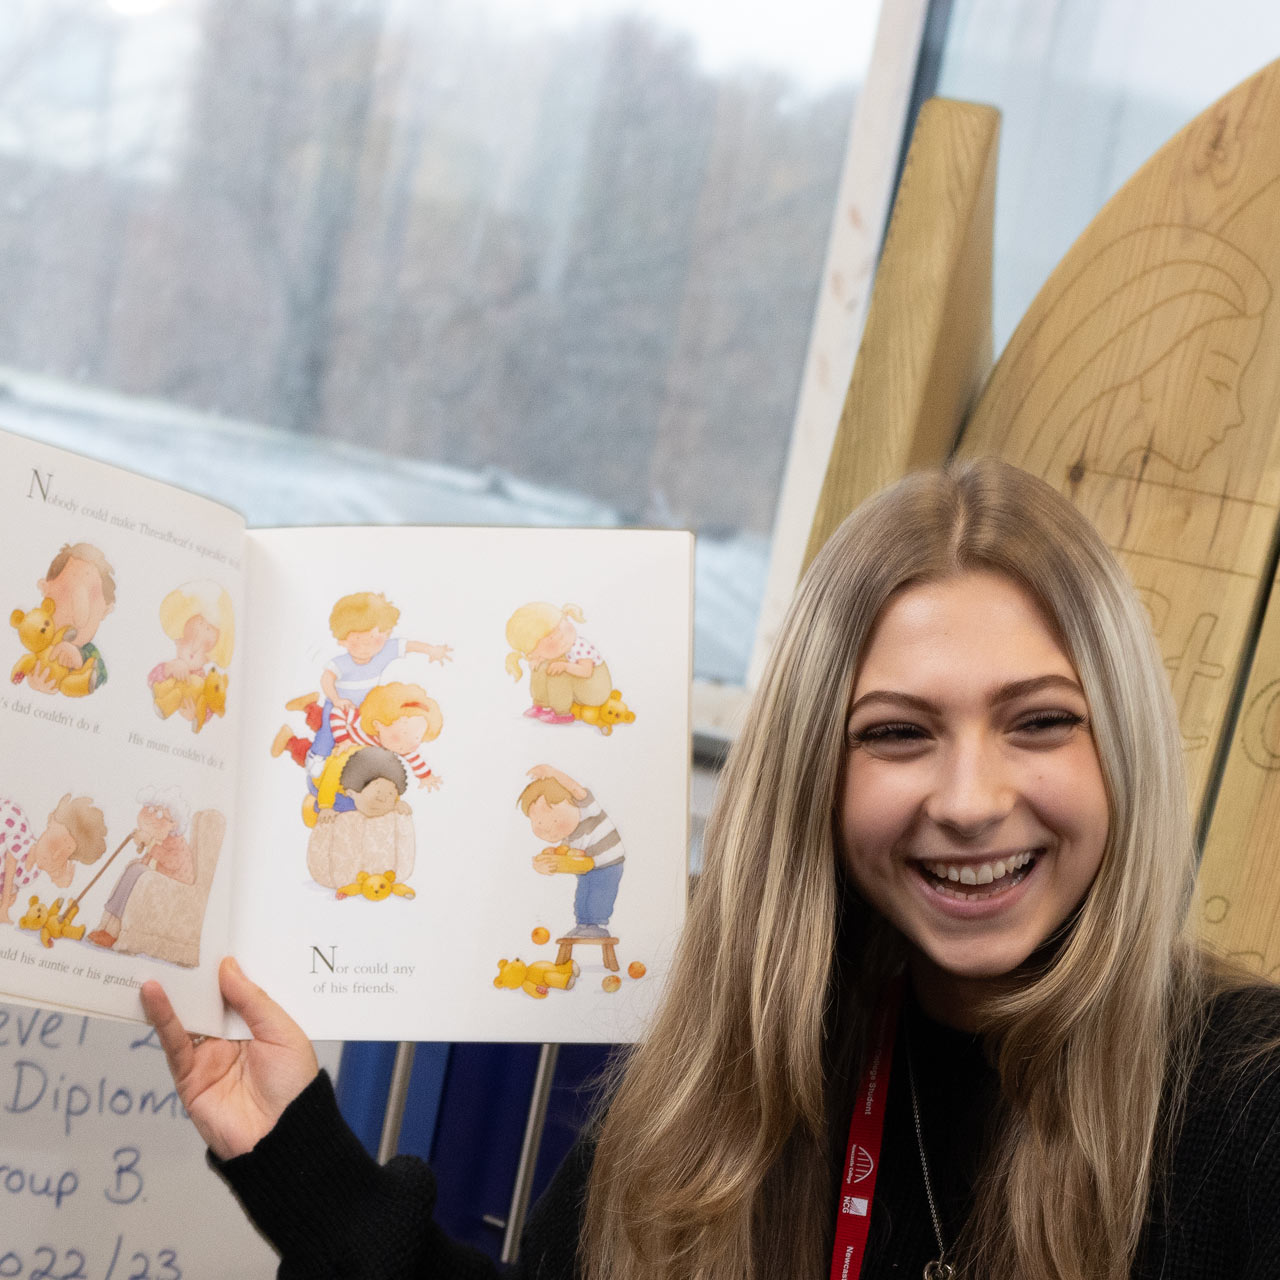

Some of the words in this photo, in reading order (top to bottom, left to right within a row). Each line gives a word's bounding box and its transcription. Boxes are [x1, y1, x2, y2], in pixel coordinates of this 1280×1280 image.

[26, 468, 77, 512] Nobody
[81, 505, 108, 522] could
[110, 514, 136, 531] make
[11, 699, 31, 715] dad
[33, 705, 74, 728] couldn't
[76, 717, 90, 731] do
[128, 732, 144, 746] His
[146, 739, 170, 753] mum
[172, 745, 205, 763] couldn't
[20, 951, 36, 965] his
[38, 956, 70, 974] auntie
[72, 967, 85, 977] or
[86, 966, 102, 980] his
[309, 945, 349, 974] Nor
[354, 962, 388, 975] could
[393, 965, 416, 977] any
[313, 981, 326, 994] of
[330, 981, 348, 994] his
[352, 981, 399, 994] friends.
[4, 1059, 193, 1136] Diplom
[861, 1081, 879, 1116] Student
[841, 1195, 851, 1214] NCG
